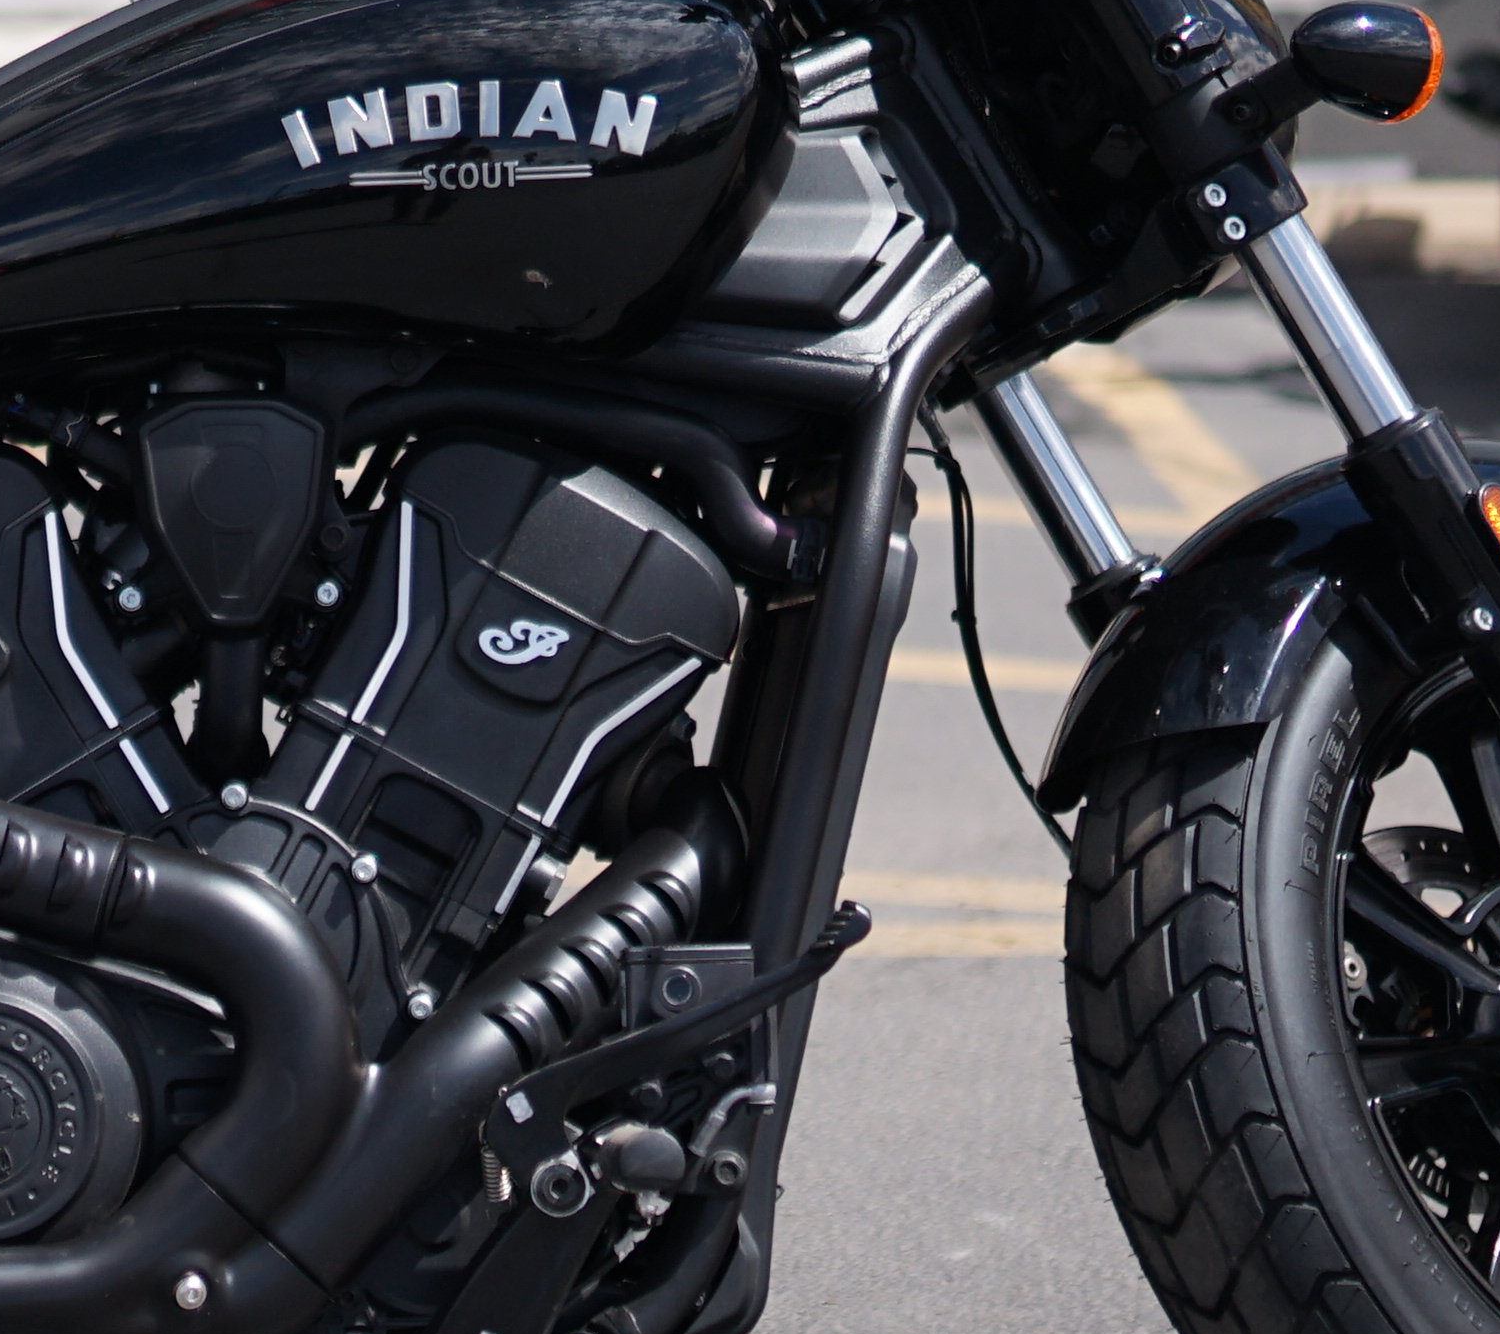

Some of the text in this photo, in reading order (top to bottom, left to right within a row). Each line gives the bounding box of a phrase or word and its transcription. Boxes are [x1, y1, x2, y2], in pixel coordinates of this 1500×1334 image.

[280, 78, 658, 170] INDIAN
[422, 159, 520, 192] SCOUT
[1301, 705, 1361, 877] PIREL
